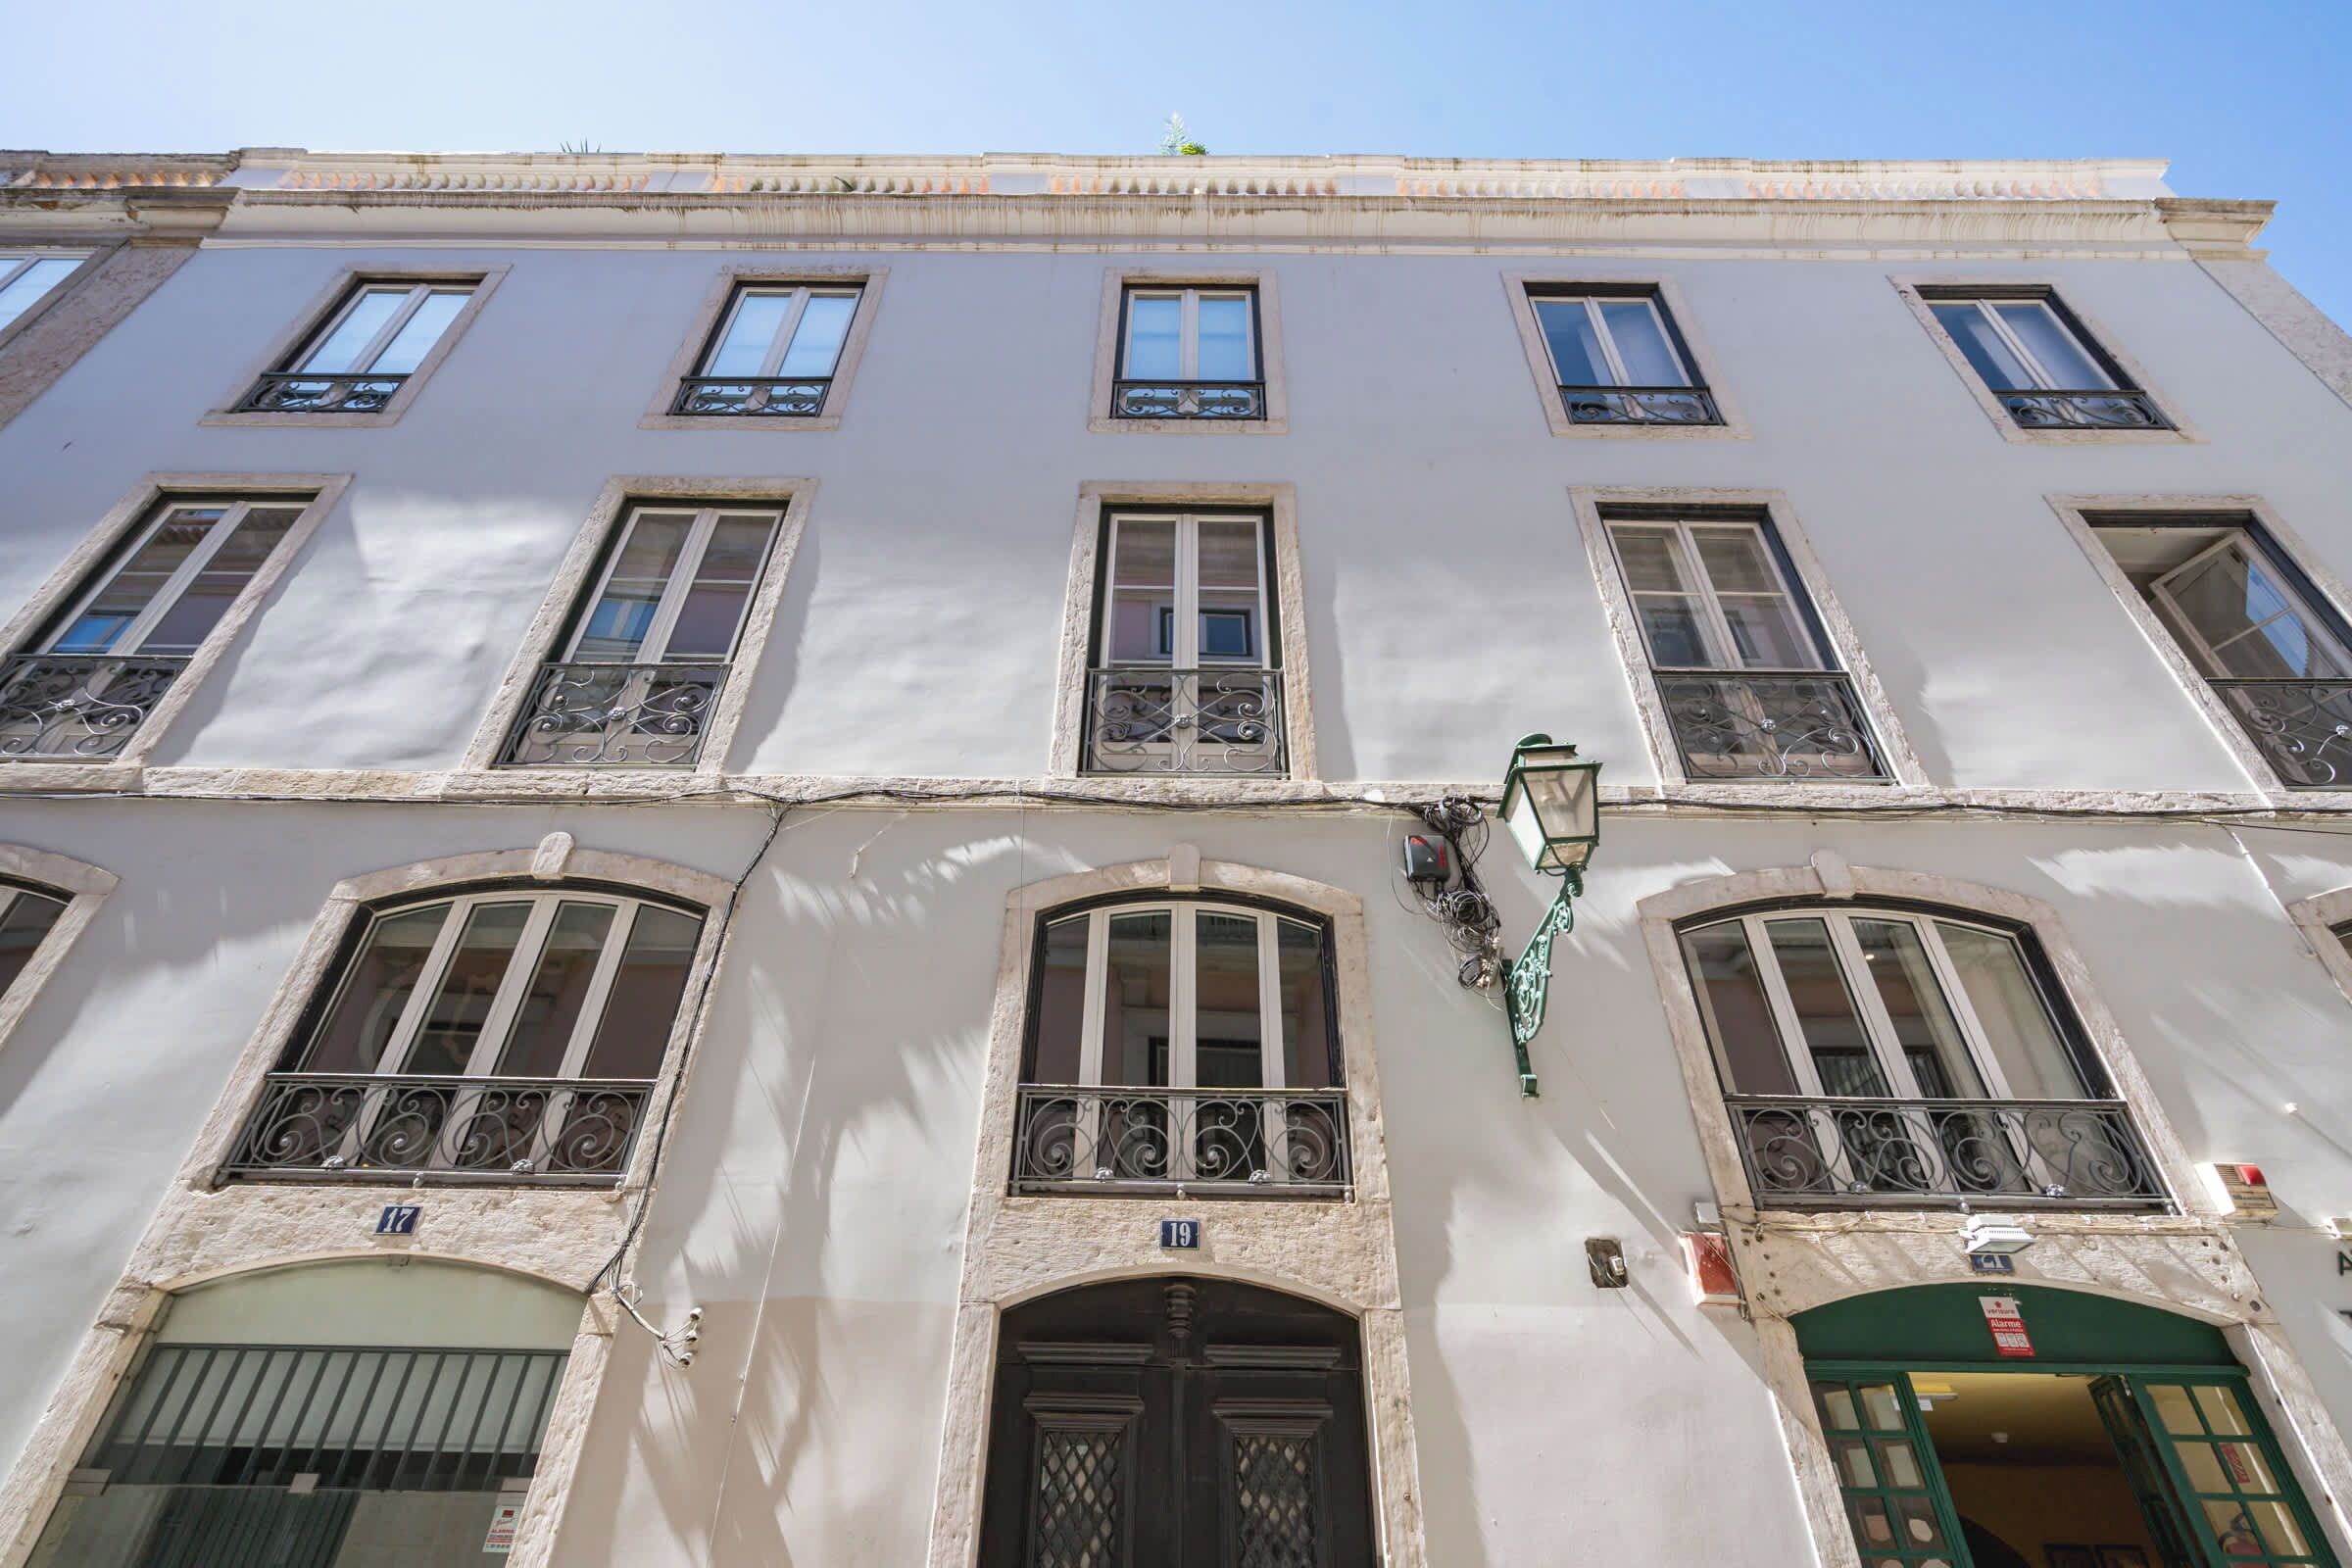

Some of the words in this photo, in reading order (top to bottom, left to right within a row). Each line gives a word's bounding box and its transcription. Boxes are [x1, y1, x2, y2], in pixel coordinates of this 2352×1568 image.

[383, 1207, 415, 1232] 17
[1170, 1222, 1191, 1247] 19
[1990, 1318, 2022, 1329] Alarme
